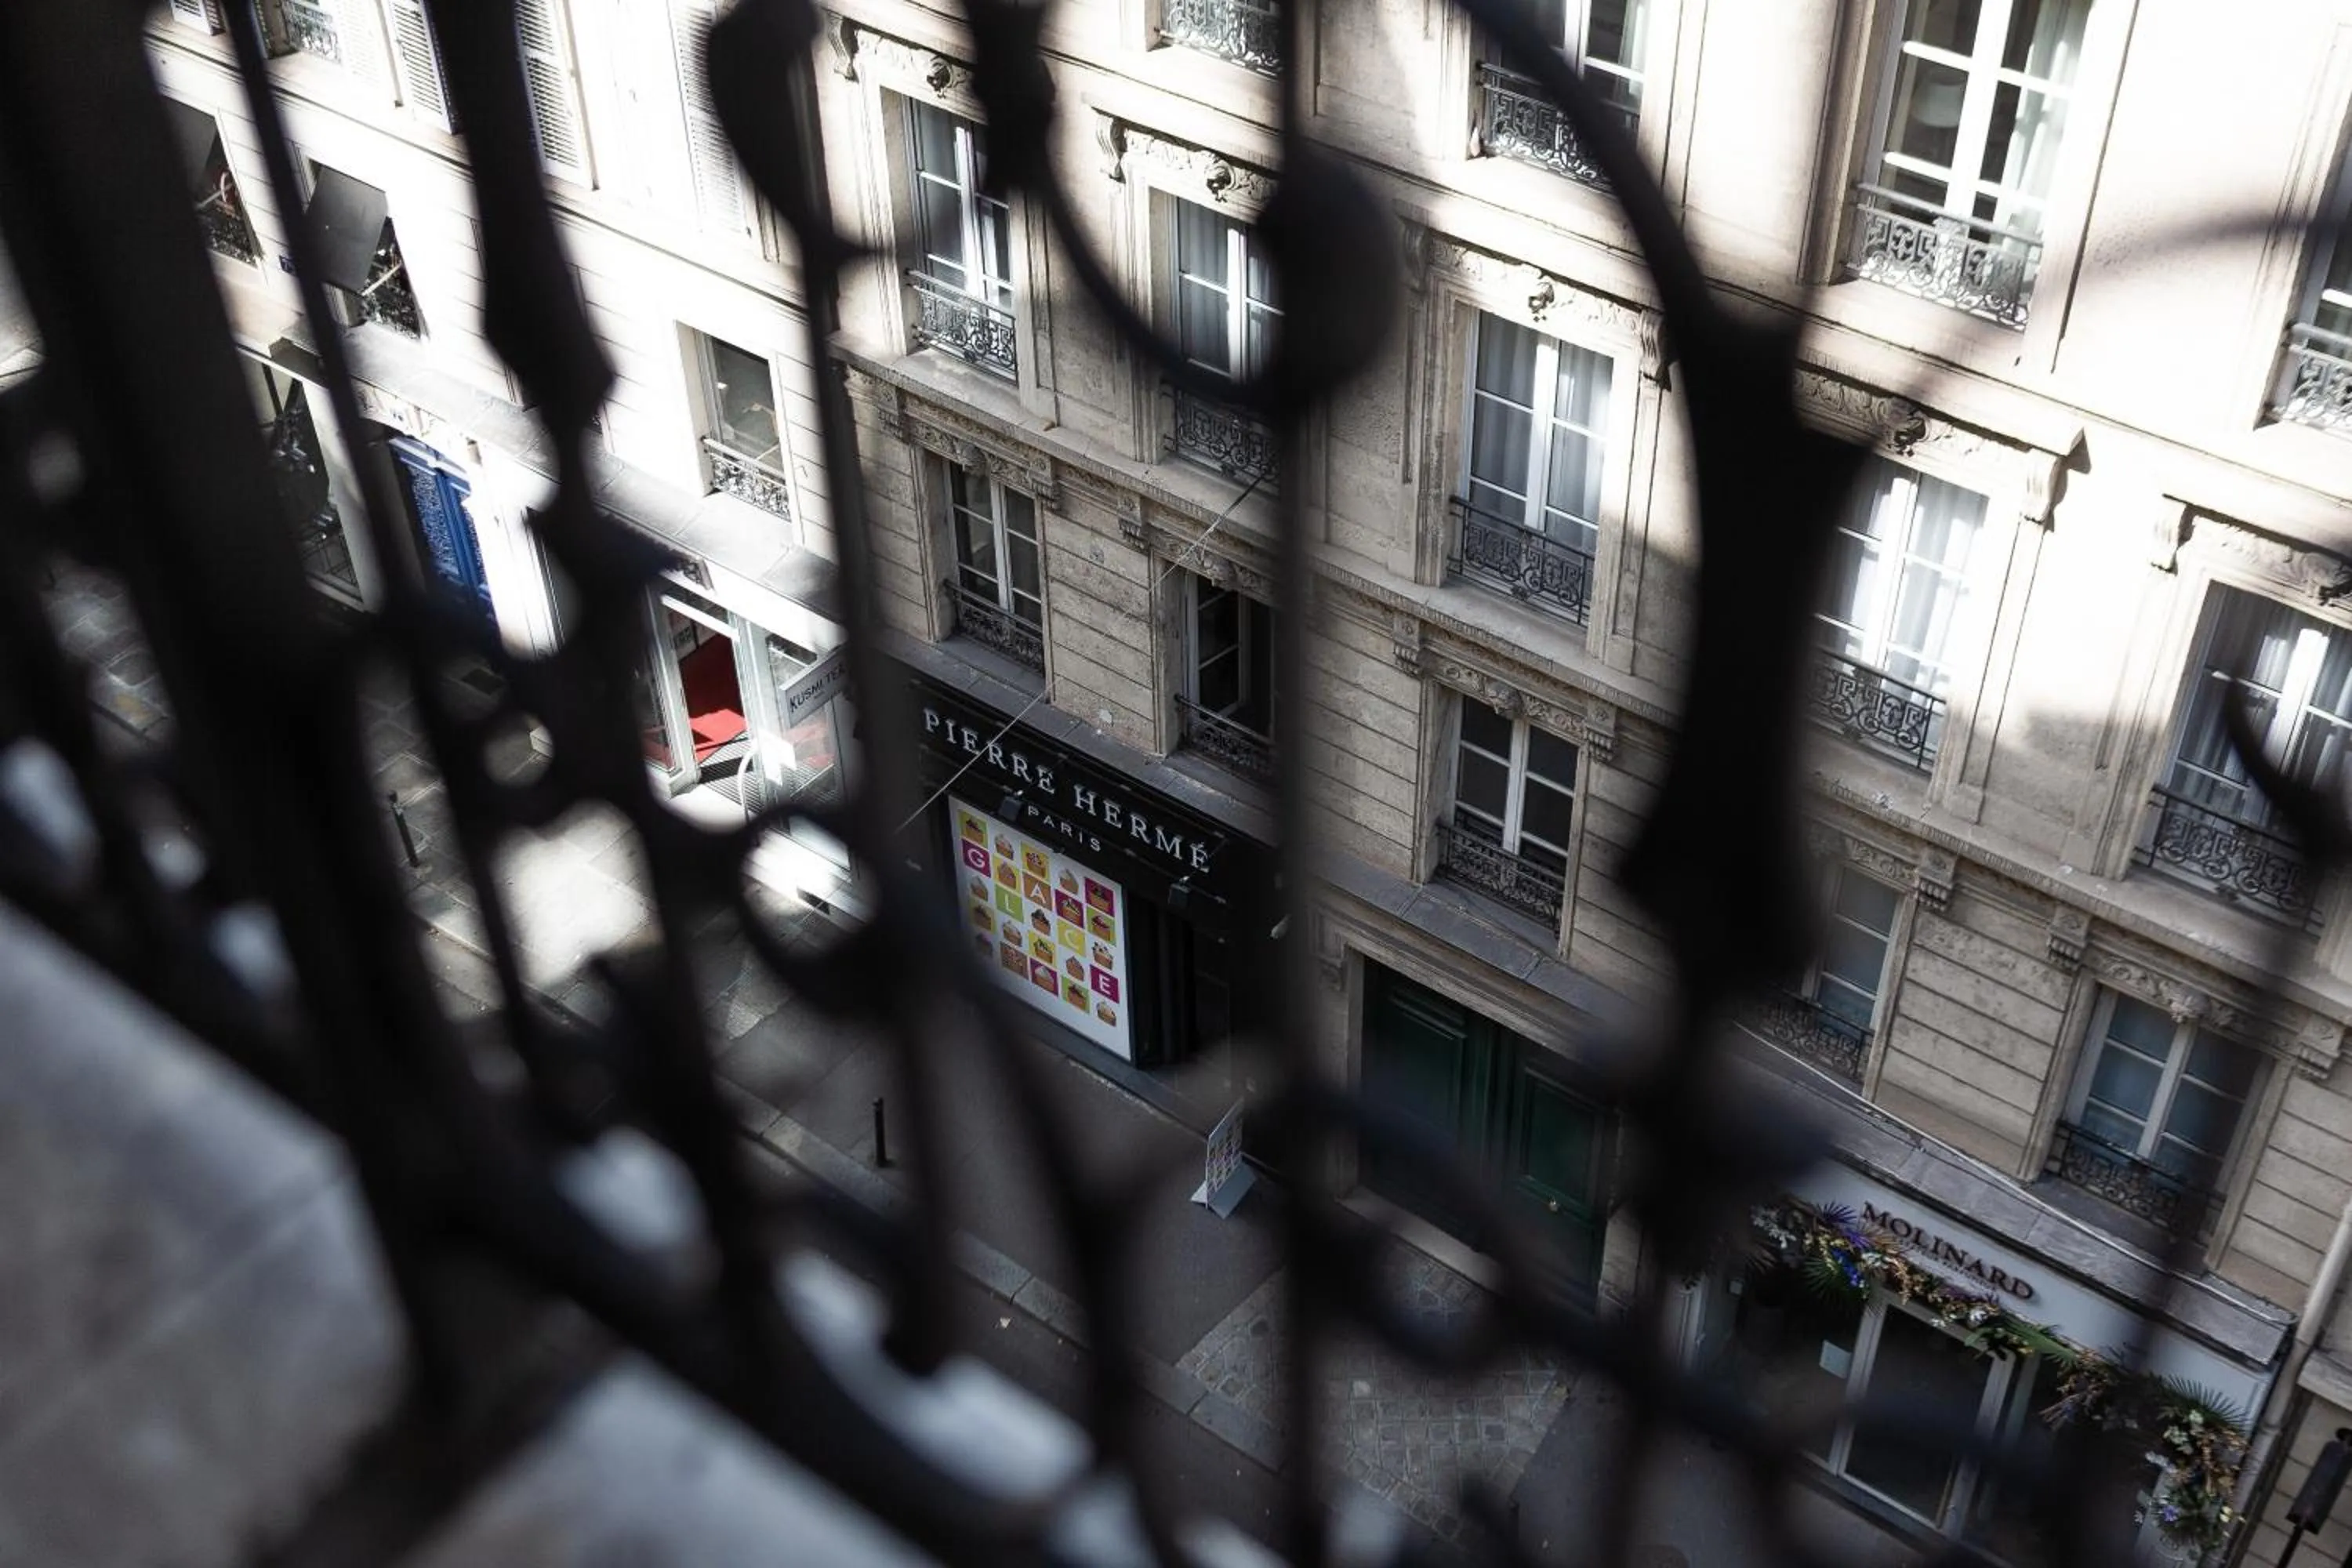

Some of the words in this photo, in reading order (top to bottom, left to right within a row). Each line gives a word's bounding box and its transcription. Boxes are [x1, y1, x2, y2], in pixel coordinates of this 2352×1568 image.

[789, 678, 822, 713] KUSMI
[923, 708, 1055, 795] PIERRE
[1073, 784, 1210, 874] HERMÉ
[1027, 805, 1102, 852] PARIS
[1860, 1200, 2035, 1301] MOLINARD
